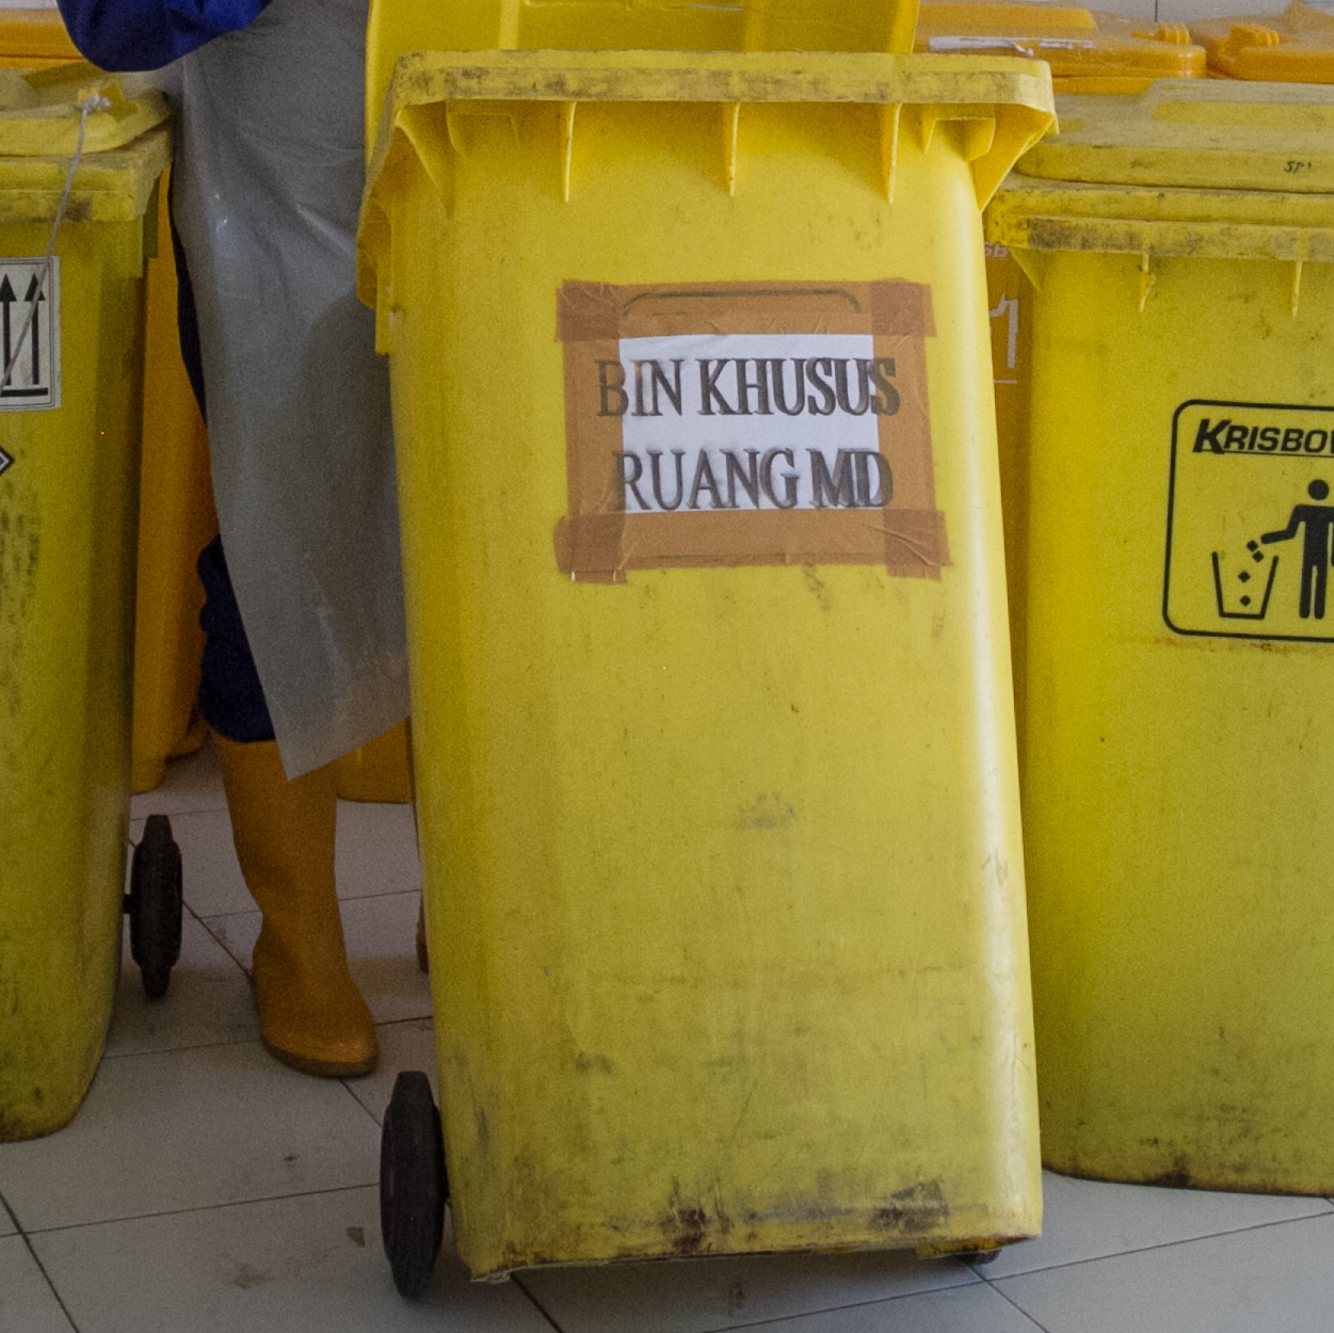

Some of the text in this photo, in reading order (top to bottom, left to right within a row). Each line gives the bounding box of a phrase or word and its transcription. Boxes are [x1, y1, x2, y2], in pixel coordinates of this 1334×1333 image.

[595, 357, 901, 417] BIN KHUSUS
[608, 448, 894, 510] RUANG MD
